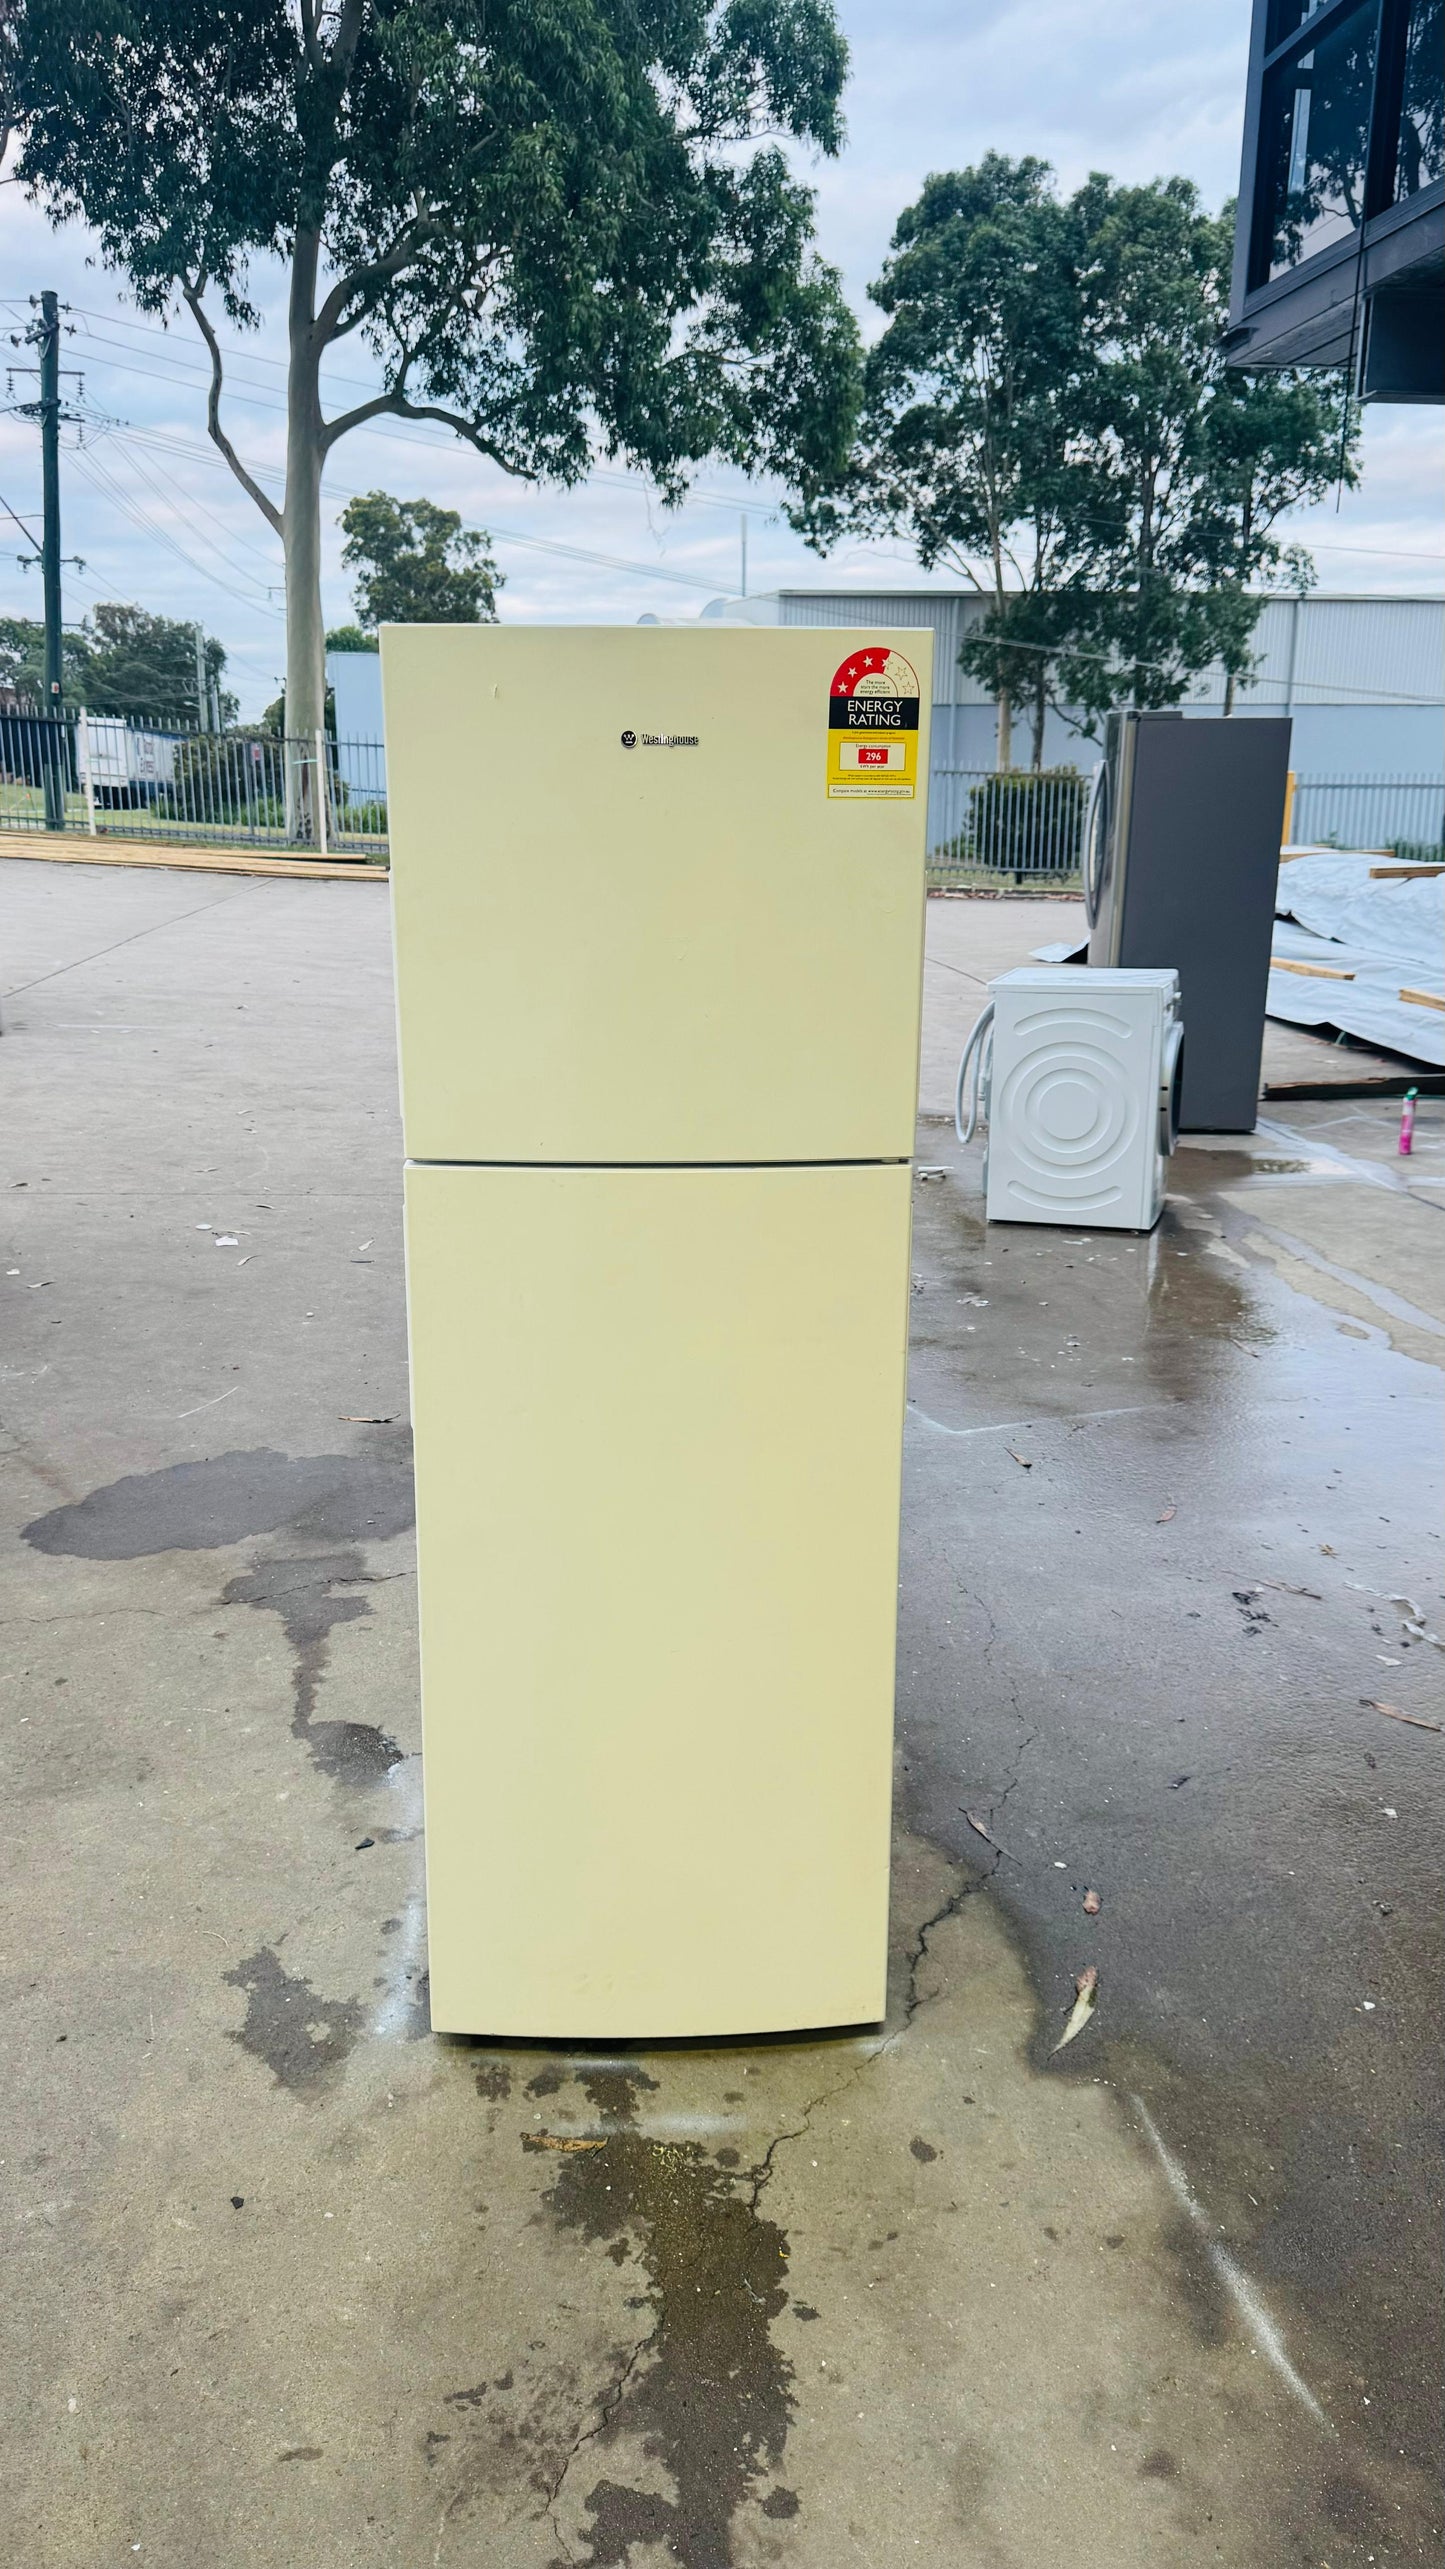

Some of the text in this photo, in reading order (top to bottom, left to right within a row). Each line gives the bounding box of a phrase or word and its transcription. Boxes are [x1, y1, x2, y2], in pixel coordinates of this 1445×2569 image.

[847, 700, 903, 712] ENERGY
[848, 714, 901, 726] RATING
[865, 752, 881, 761] 296
